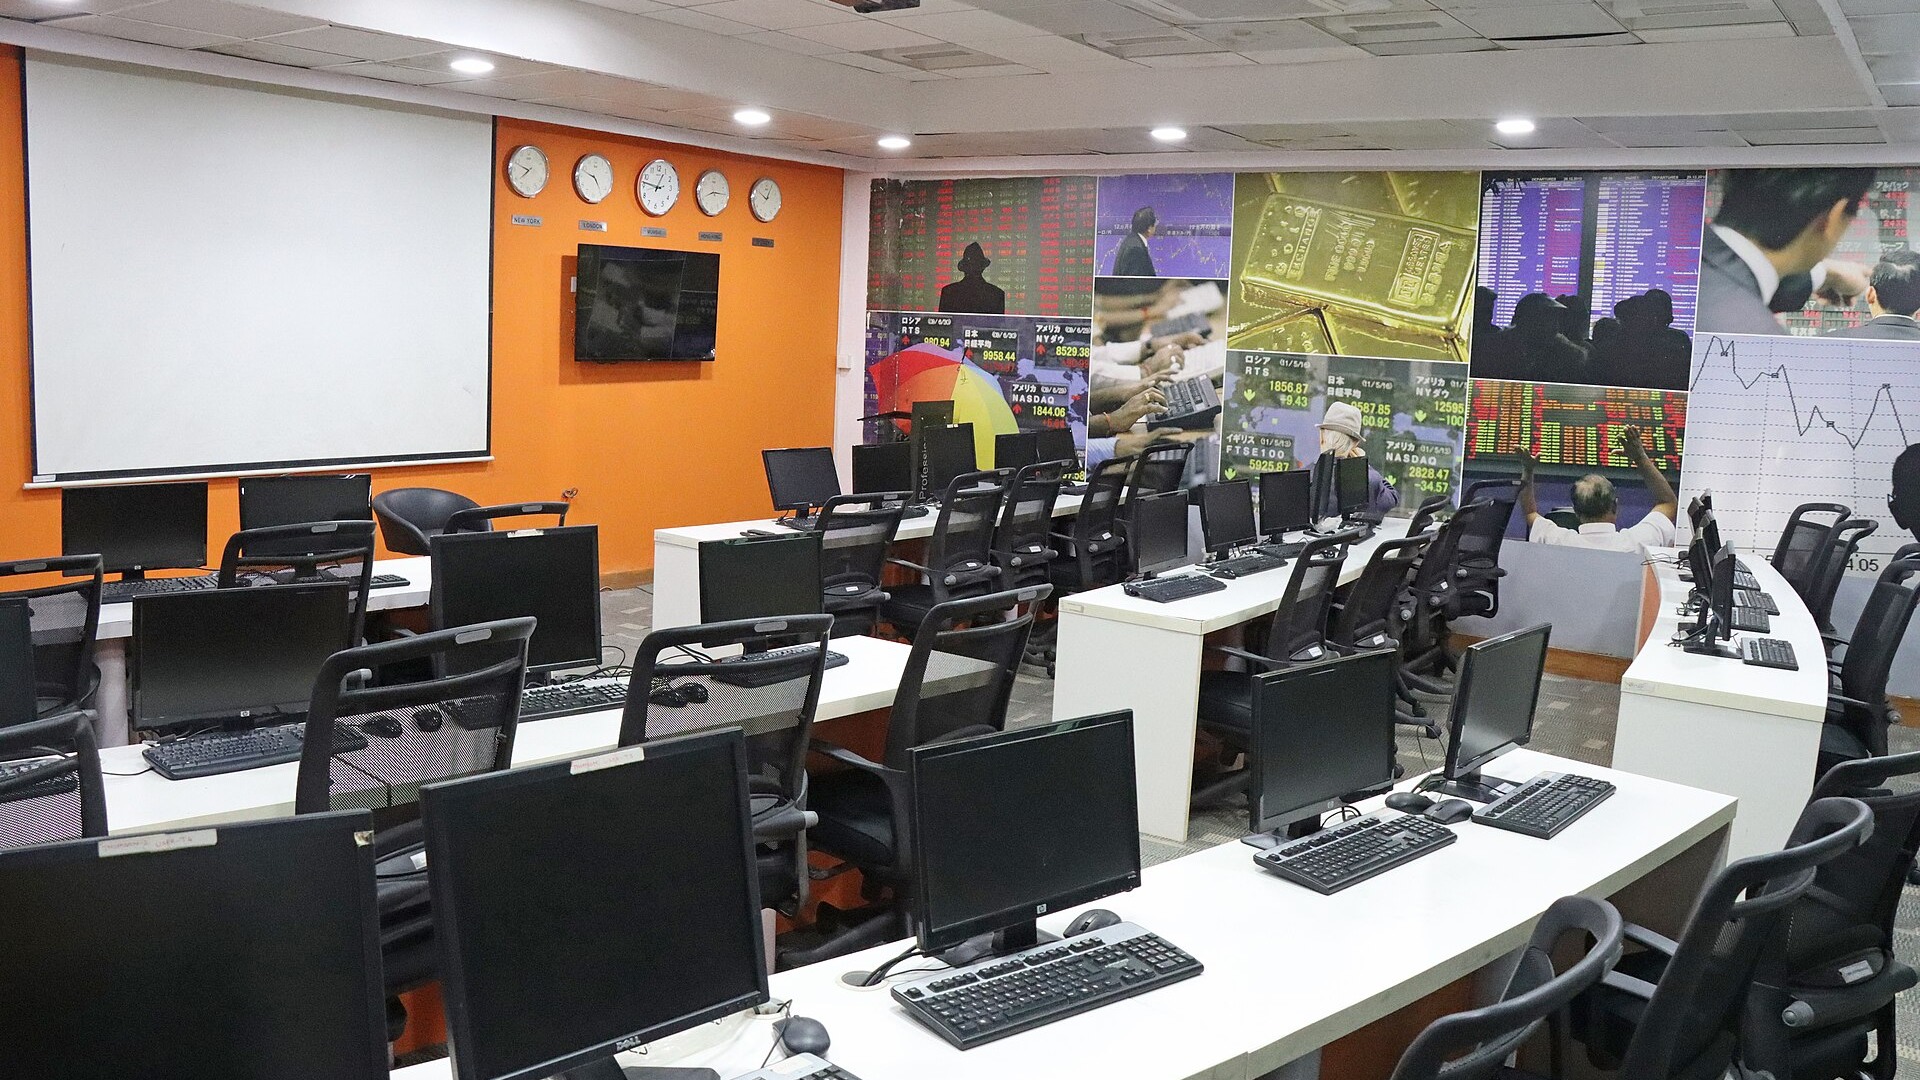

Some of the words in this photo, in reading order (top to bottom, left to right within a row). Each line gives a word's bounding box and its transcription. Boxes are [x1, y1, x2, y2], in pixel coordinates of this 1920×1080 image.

[583, 222, 603, 230] LONDON
[902, 317, 921, 325] ロシア
[902, 326, 920, 334] RTS
[964, 330, 978, 338] 日本
[1036, 324, 1060, 333] アメリカ
[983, 350, 1016, 361] 9958.44
[1056, 346, 1090, 358] 8529.38
[1245, 355, 1271, 365] ロシア
[1245, 366, 1270, 377] RTS
[1328, 375, 1344, 386] 日本
[1416, 376, 1446, 386] アメリカ
[1012, 384, 1036, 392] アメリカ
[1270, 380, 1308, 394] 1856.87
[1012, 394, 1054, 404] NASDAQ
[1033, 406, 1066, 417] 1844.06
[1434, 400, 1464, 414] 12595
[1226, 434, 1255, 444] イギリス
[1386, 441, 1415, 451] アメリカ
[1226, 445, 1285, 459] FTSE100
[1386, 452, 1437, 465] NASDAQ
[1249, 459, 1289, 472] 5925.87
[1409, 466, 1449, 480] 2828.47
[1414, 481, 1448, 493] -34.57
[616, 1036, 641, 1051] DELL
